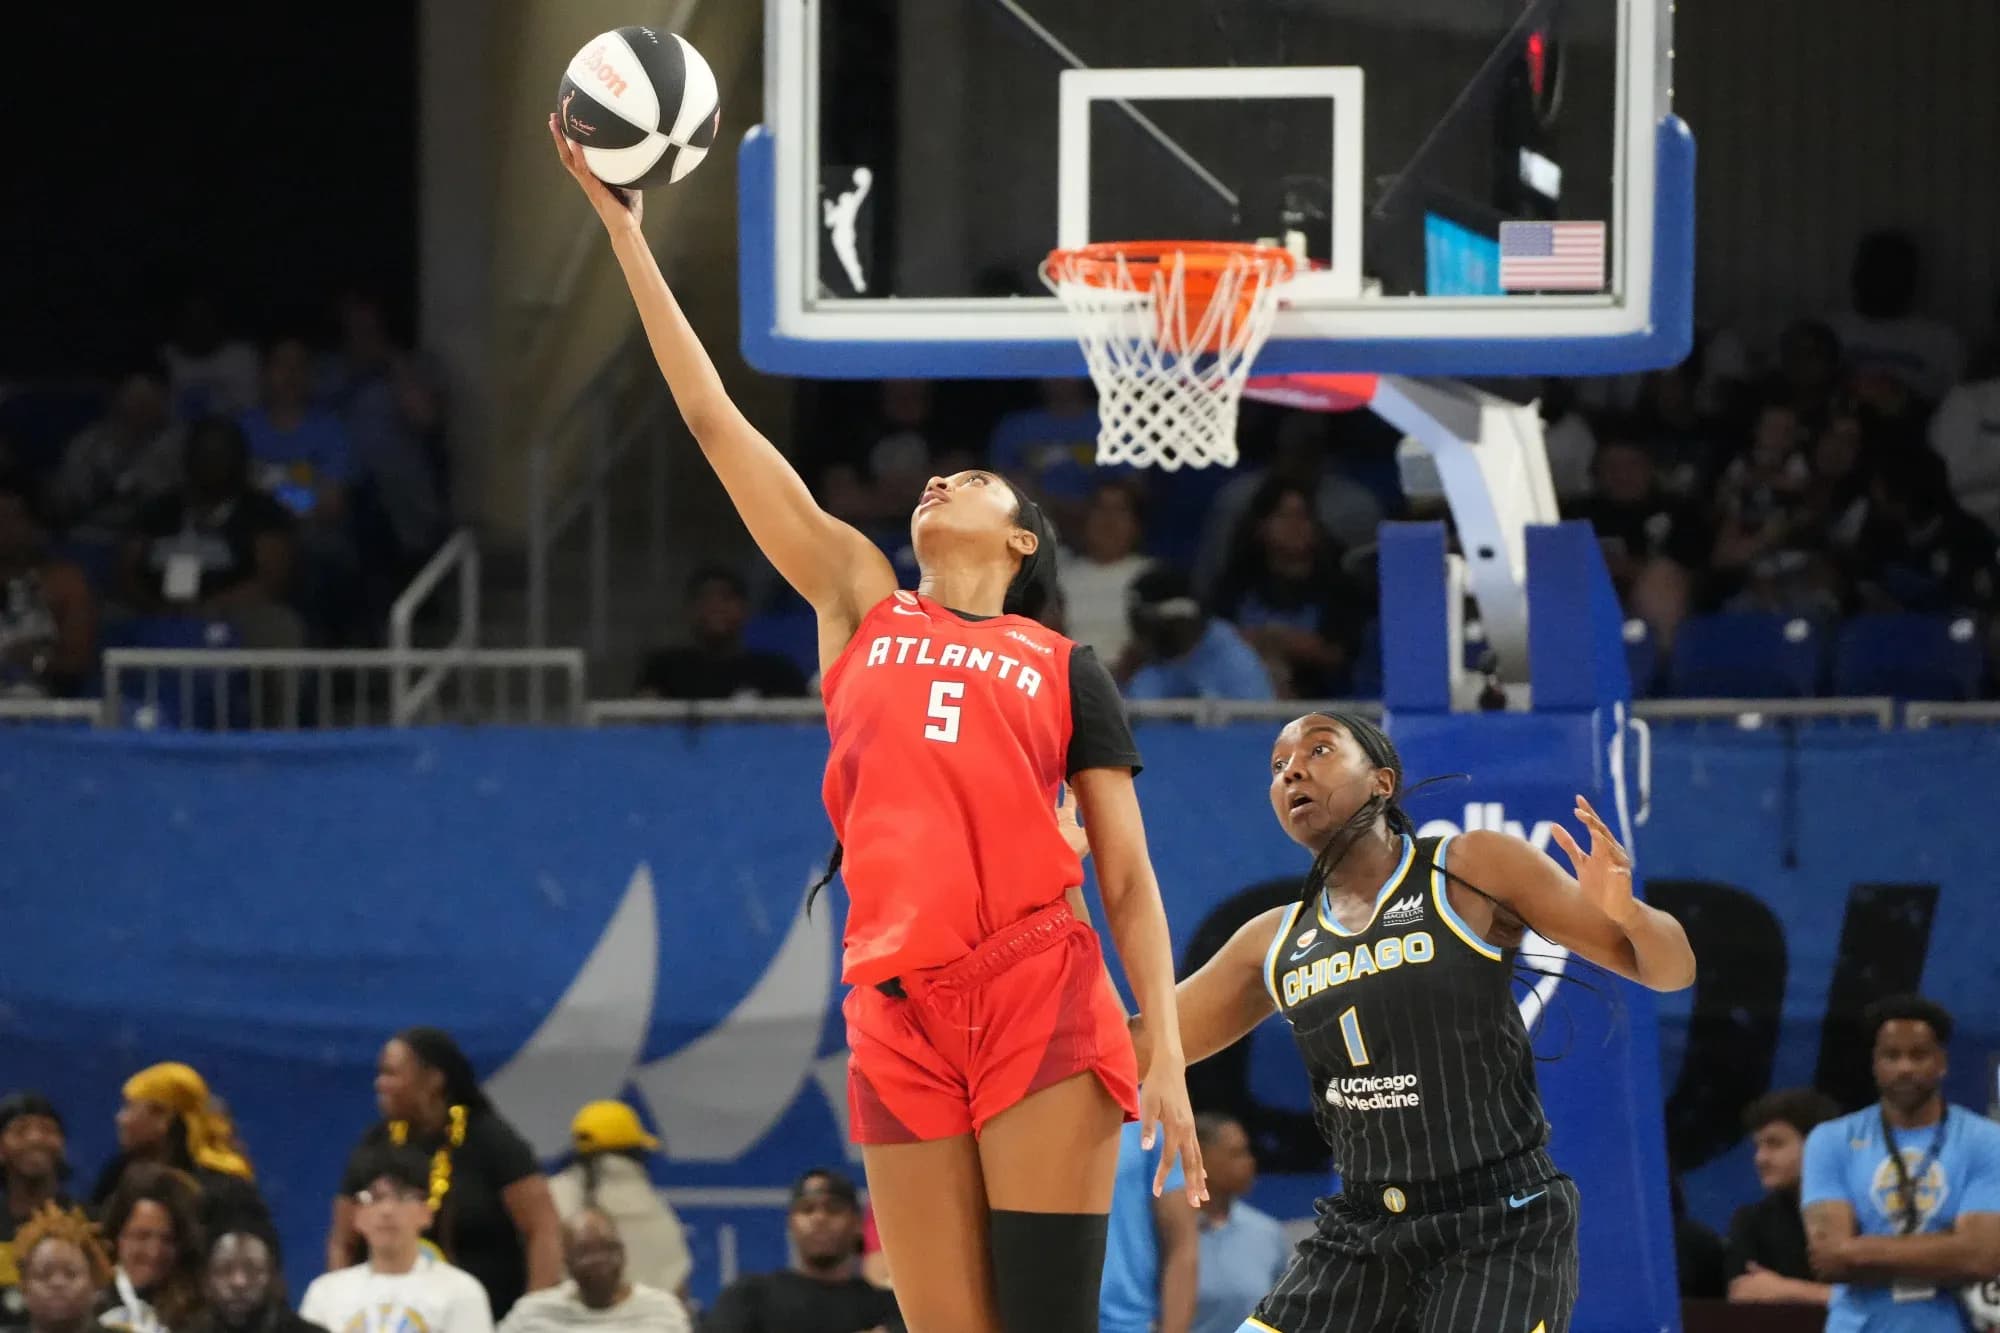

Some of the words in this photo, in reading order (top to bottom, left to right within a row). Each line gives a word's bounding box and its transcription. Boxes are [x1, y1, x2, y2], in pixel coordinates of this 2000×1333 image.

[866, 635, 1042, 697] ATLANTA
[924, 680, 965, 743] 5
[1282, 931, 1435, 1007] CHICAGO
[1339, 1005, 1370, 1067] 1
[1340, 1074, 1417, 1093] UChicago
[1343, 1091, 1420, 1111] Medicine
